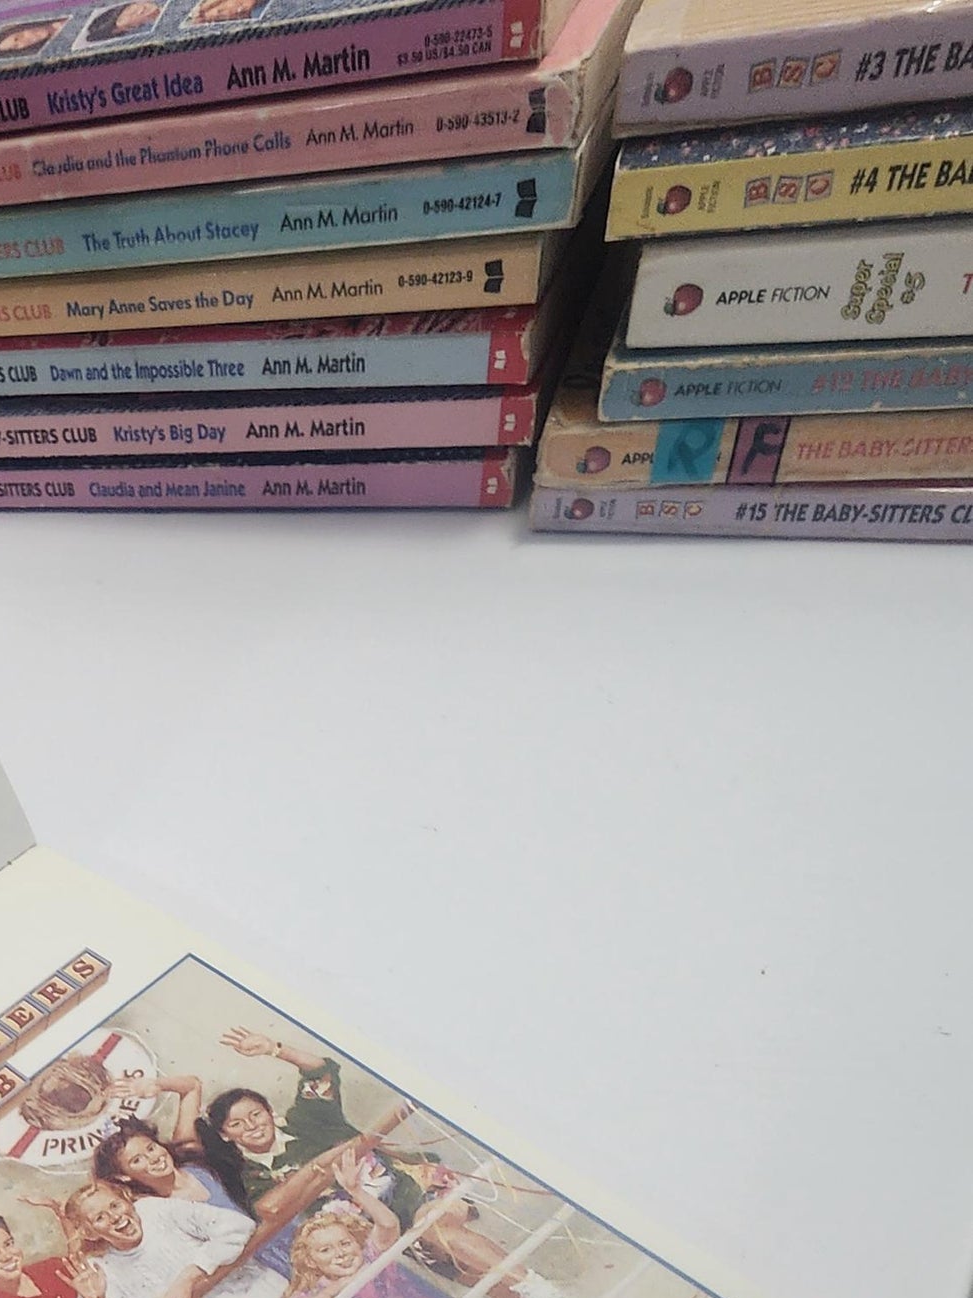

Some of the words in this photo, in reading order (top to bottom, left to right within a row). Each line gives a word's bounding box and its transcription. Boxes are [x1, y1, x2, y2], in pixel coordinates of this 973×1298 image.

[855, 51, 886, 83] #3
[894, 43, 942, 78] THE
[47, 87, 107, 114] Kristy's
[111, 80, 158, 101] Great
[165, 73, 203, 96] Idea
[227, 64, 266, 90] Ann
[273, 58, 296, 83] M.
[303, 45, 370, 79] Martin
[33, 157, 82, 177] Claudia
[88, 151, 112, 170] and
[115, 148, 137, 167] the
[140, 145, 201, 165] Phantom
[205, 137, 249, 158] Phone
[253, 131, 291, 152] Calls
[306, 128, 336, 145] Ann
[340, 125, 359, 142] M.
[363, 120, 414, 140] Martin
[850, 167, 878, 195] #4
[887, 162, 931, 191] THE
[26, 237, 67, 257] CLUB
[82, 233, 110, 251] The
[112, 228, 150, 249] Truth
[154, 224, 201, 245] About
[206, 221, 259, 241] Stacey
[280, 215, 313, 232] Ann
[317, 211, 338, 229] M.
[343, 204, 398, 226] Martin
[398, 270, 473, 288] 0-590-42123-9
[13, 303, 52, 321] CLUB
[67, 302, 104, 320] Mary
[109, 297, 145, 315] Anne
[150, 294, 191, 312] Saves
[195, 291, 218, 308] the
[223, 290, 253, 309] Day
[272, 286, 302, 302] Ann
[308, 283, 327, 299] M.
[331, 279, 383, 298] Martin
[716, 289, 767, 305] APPLE
[771, 286, 831, 302] FICTION
[7, 364, 37, 382] CLUB
[50, 364, 82, 382] Dawn
[86, 362, 108, 381] and
[112, 362, 132, 379] the
[135, 361, 204, 381] Impossible
[208, 359, 244, 377] Three
[262, 357, 291, 375] Ann
[295, 355, 312, 374] M.
[317, 352, 365, 373] Martin
[675, 382, 722, 397] APPLE
[728, 379, 783, 395] FICTION
[62, 427, 97, 444] CLUB
[114, 425, 165, 445] Kristy's
[170, 425, 193, 443] Big
[198, 423, 226, 443] Day
[246, 422, 279, 438] Ann
[284, 420, 304, 438] M.
[310, 417, 365, 437] Martin
[797, 442, 835, 459] THE
[45, 481, 75, 496] CLUB
[89, 481, 134, 498] Claudia
[139, 481, 161, 497] and
[166, 481, 199, 497] Mean
[203, 480, 246, 497] Janine
[262, 480, 291, 496] Ann
[295, 479, 313, 495] M.
[317, 477, 366, 496] Martin
[735, 503, 768, 521] #15
[774, 503, 808, 522] THE
[811, 504, 946, 524] BABY-SITTERS
